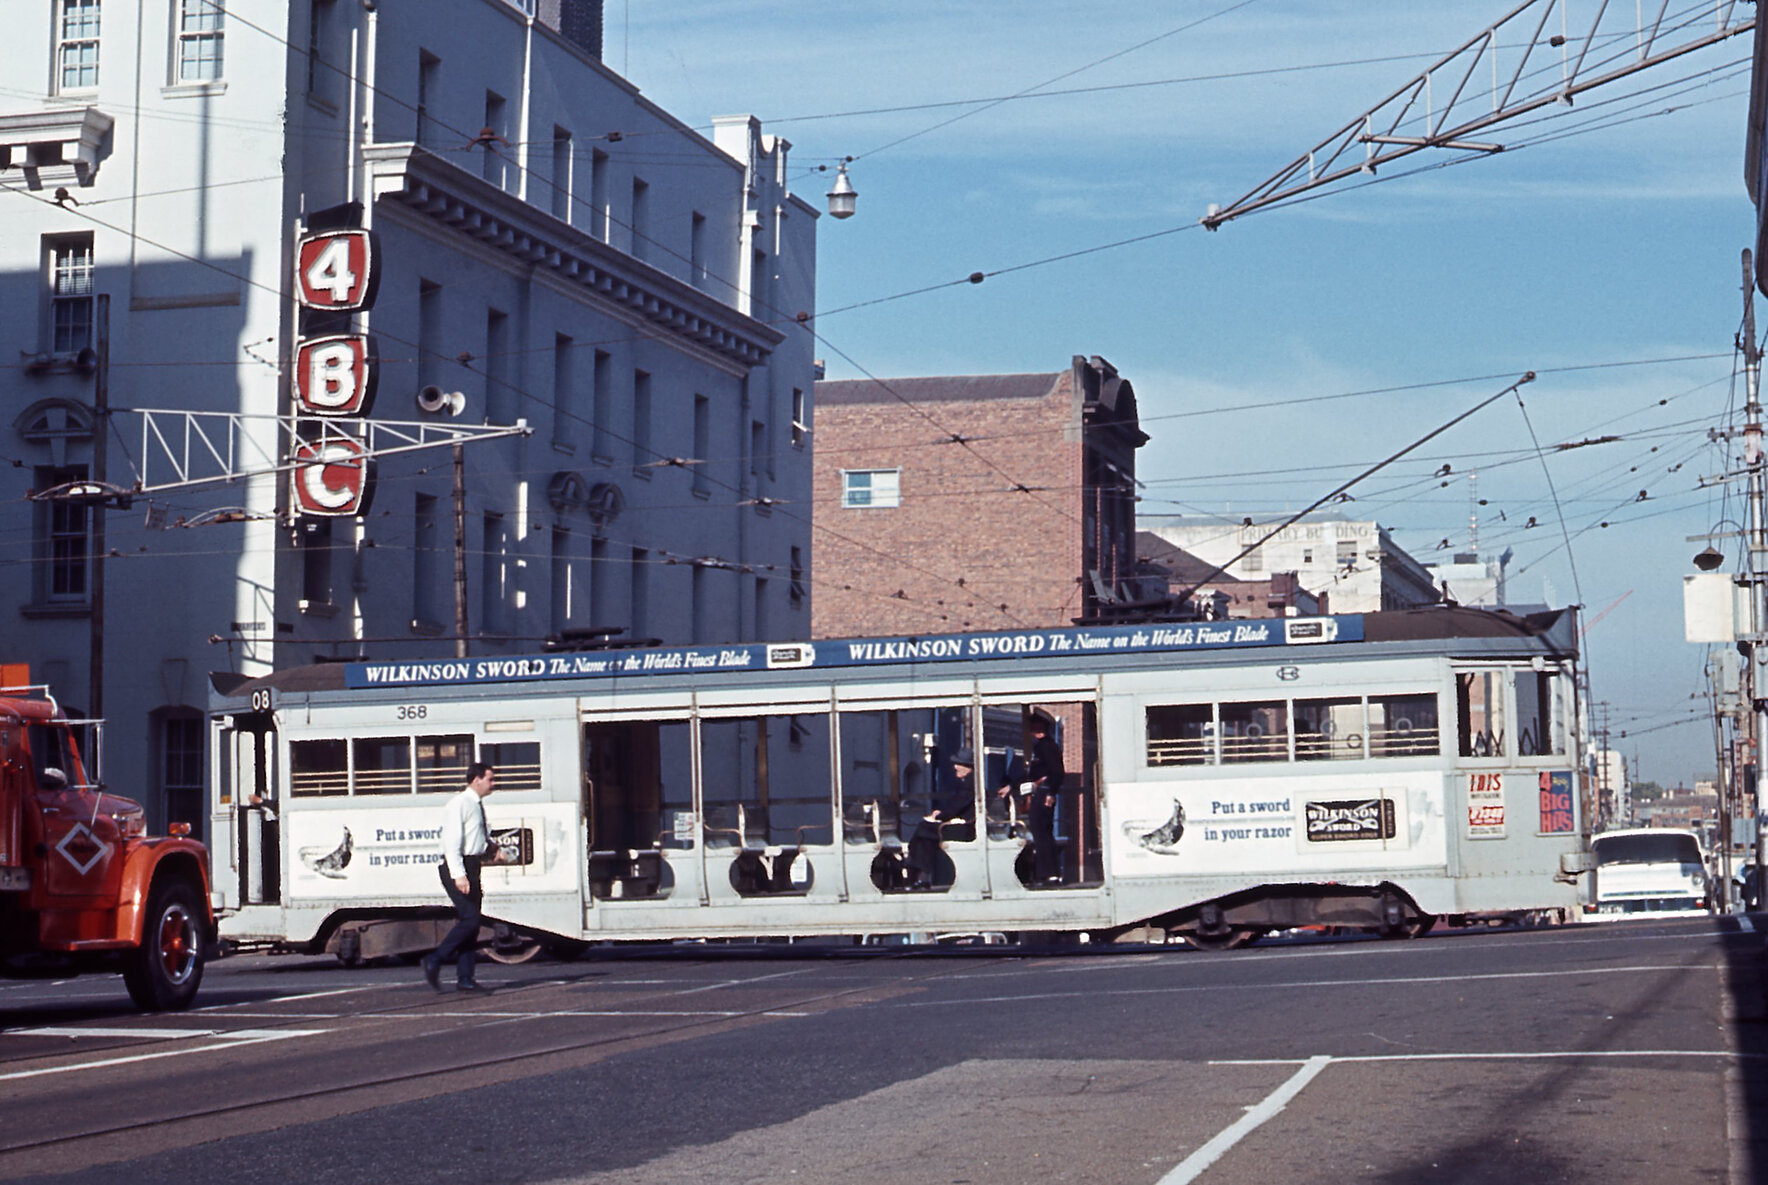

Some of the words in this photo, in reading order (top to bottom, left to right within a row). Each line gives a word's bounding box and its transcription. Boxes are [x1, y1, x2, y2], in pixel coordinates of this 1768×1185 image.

[1306, 525, 1368, 539] BUDING
[849, 640, 961, 660] WILKINSON
[969, 635, 1044, 655] SWORD
[1050, 634, 1072, 650] The
[1074, 633, 1111, 650] Name
[1113, 636, 1128, 648] on
[1131, 631, 1149, 647] the
[1152, 629, 1194, 646] World's
[1196, 628, 1230, 644] Finest
[1234, 625, 1269, 642] Blade
[366, 663, 470, 683] WILKINSON
[476, 659, 546, 679] SWORD
[550, 658, 570, 674] The
[572, 657, 605, 673] Name
[624, 655, 642, 670] the
[643, 653, 682, 669] World's
[684, 652, 715, 668] Finest
[718, 650, 751, 666] Blade
[252, 690, 270, 711] 08
[397, 705, 428, 720] 368
[1212, 801, 1235, 814] Put
[1238, 803, 1246, 813] a
[1249, 798, 1290, 813] sword
[1540, 791, 1570, 811] BIG
[1308, 807, 1379, 821] WILKINSON
[376, 828, 396, 842] Put
[398, 831, 406, 841] a
[1204, 828, 1218, 841] in
[1222, 828, 1252, 842] your
[1255, 826, 1292, 839] razor
[369, 853, 381, 866] in
[384, 854, 410, 868] your
